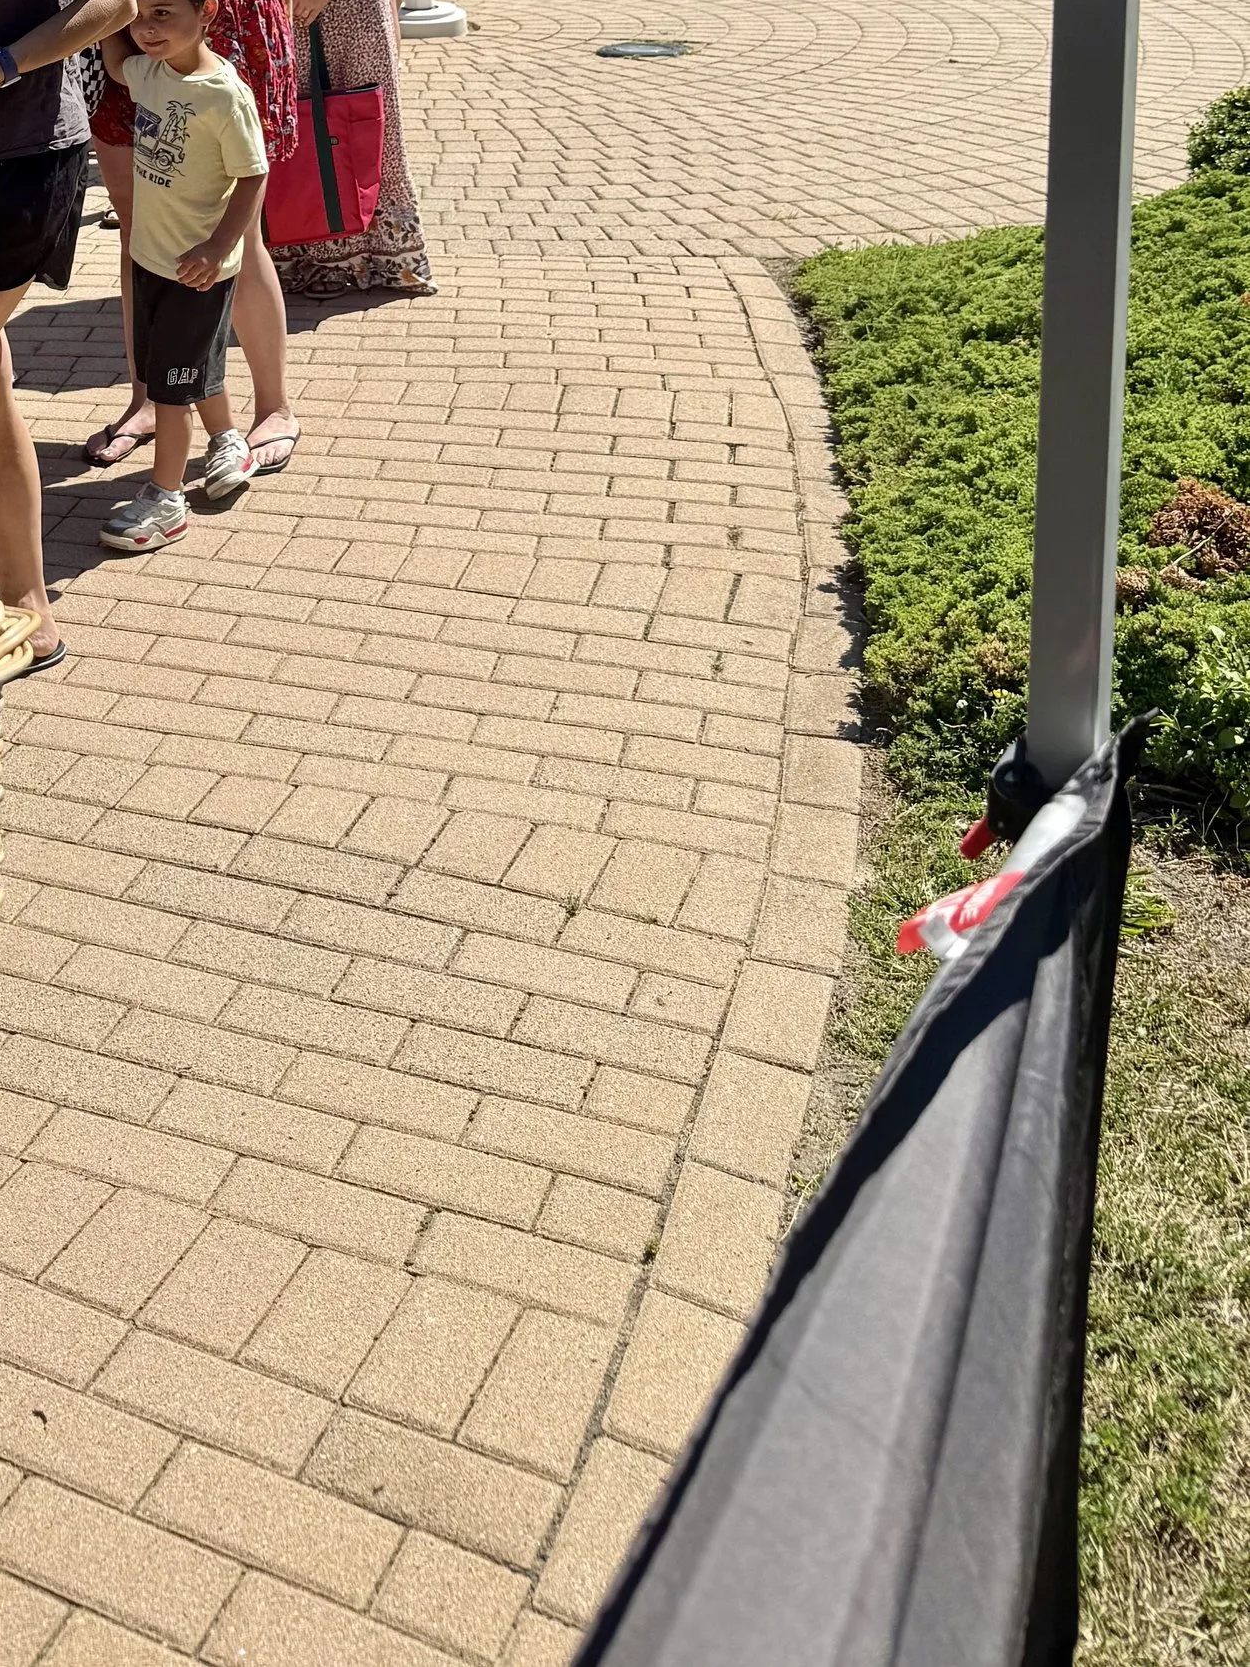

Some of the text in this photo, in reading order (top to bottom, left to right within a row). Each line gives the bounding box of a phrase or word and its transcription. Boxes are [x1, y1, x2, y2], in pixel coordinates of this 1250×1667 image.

[136, 164, 172, 188] THE RIDE
[167, 367, 199, 385] GAP
